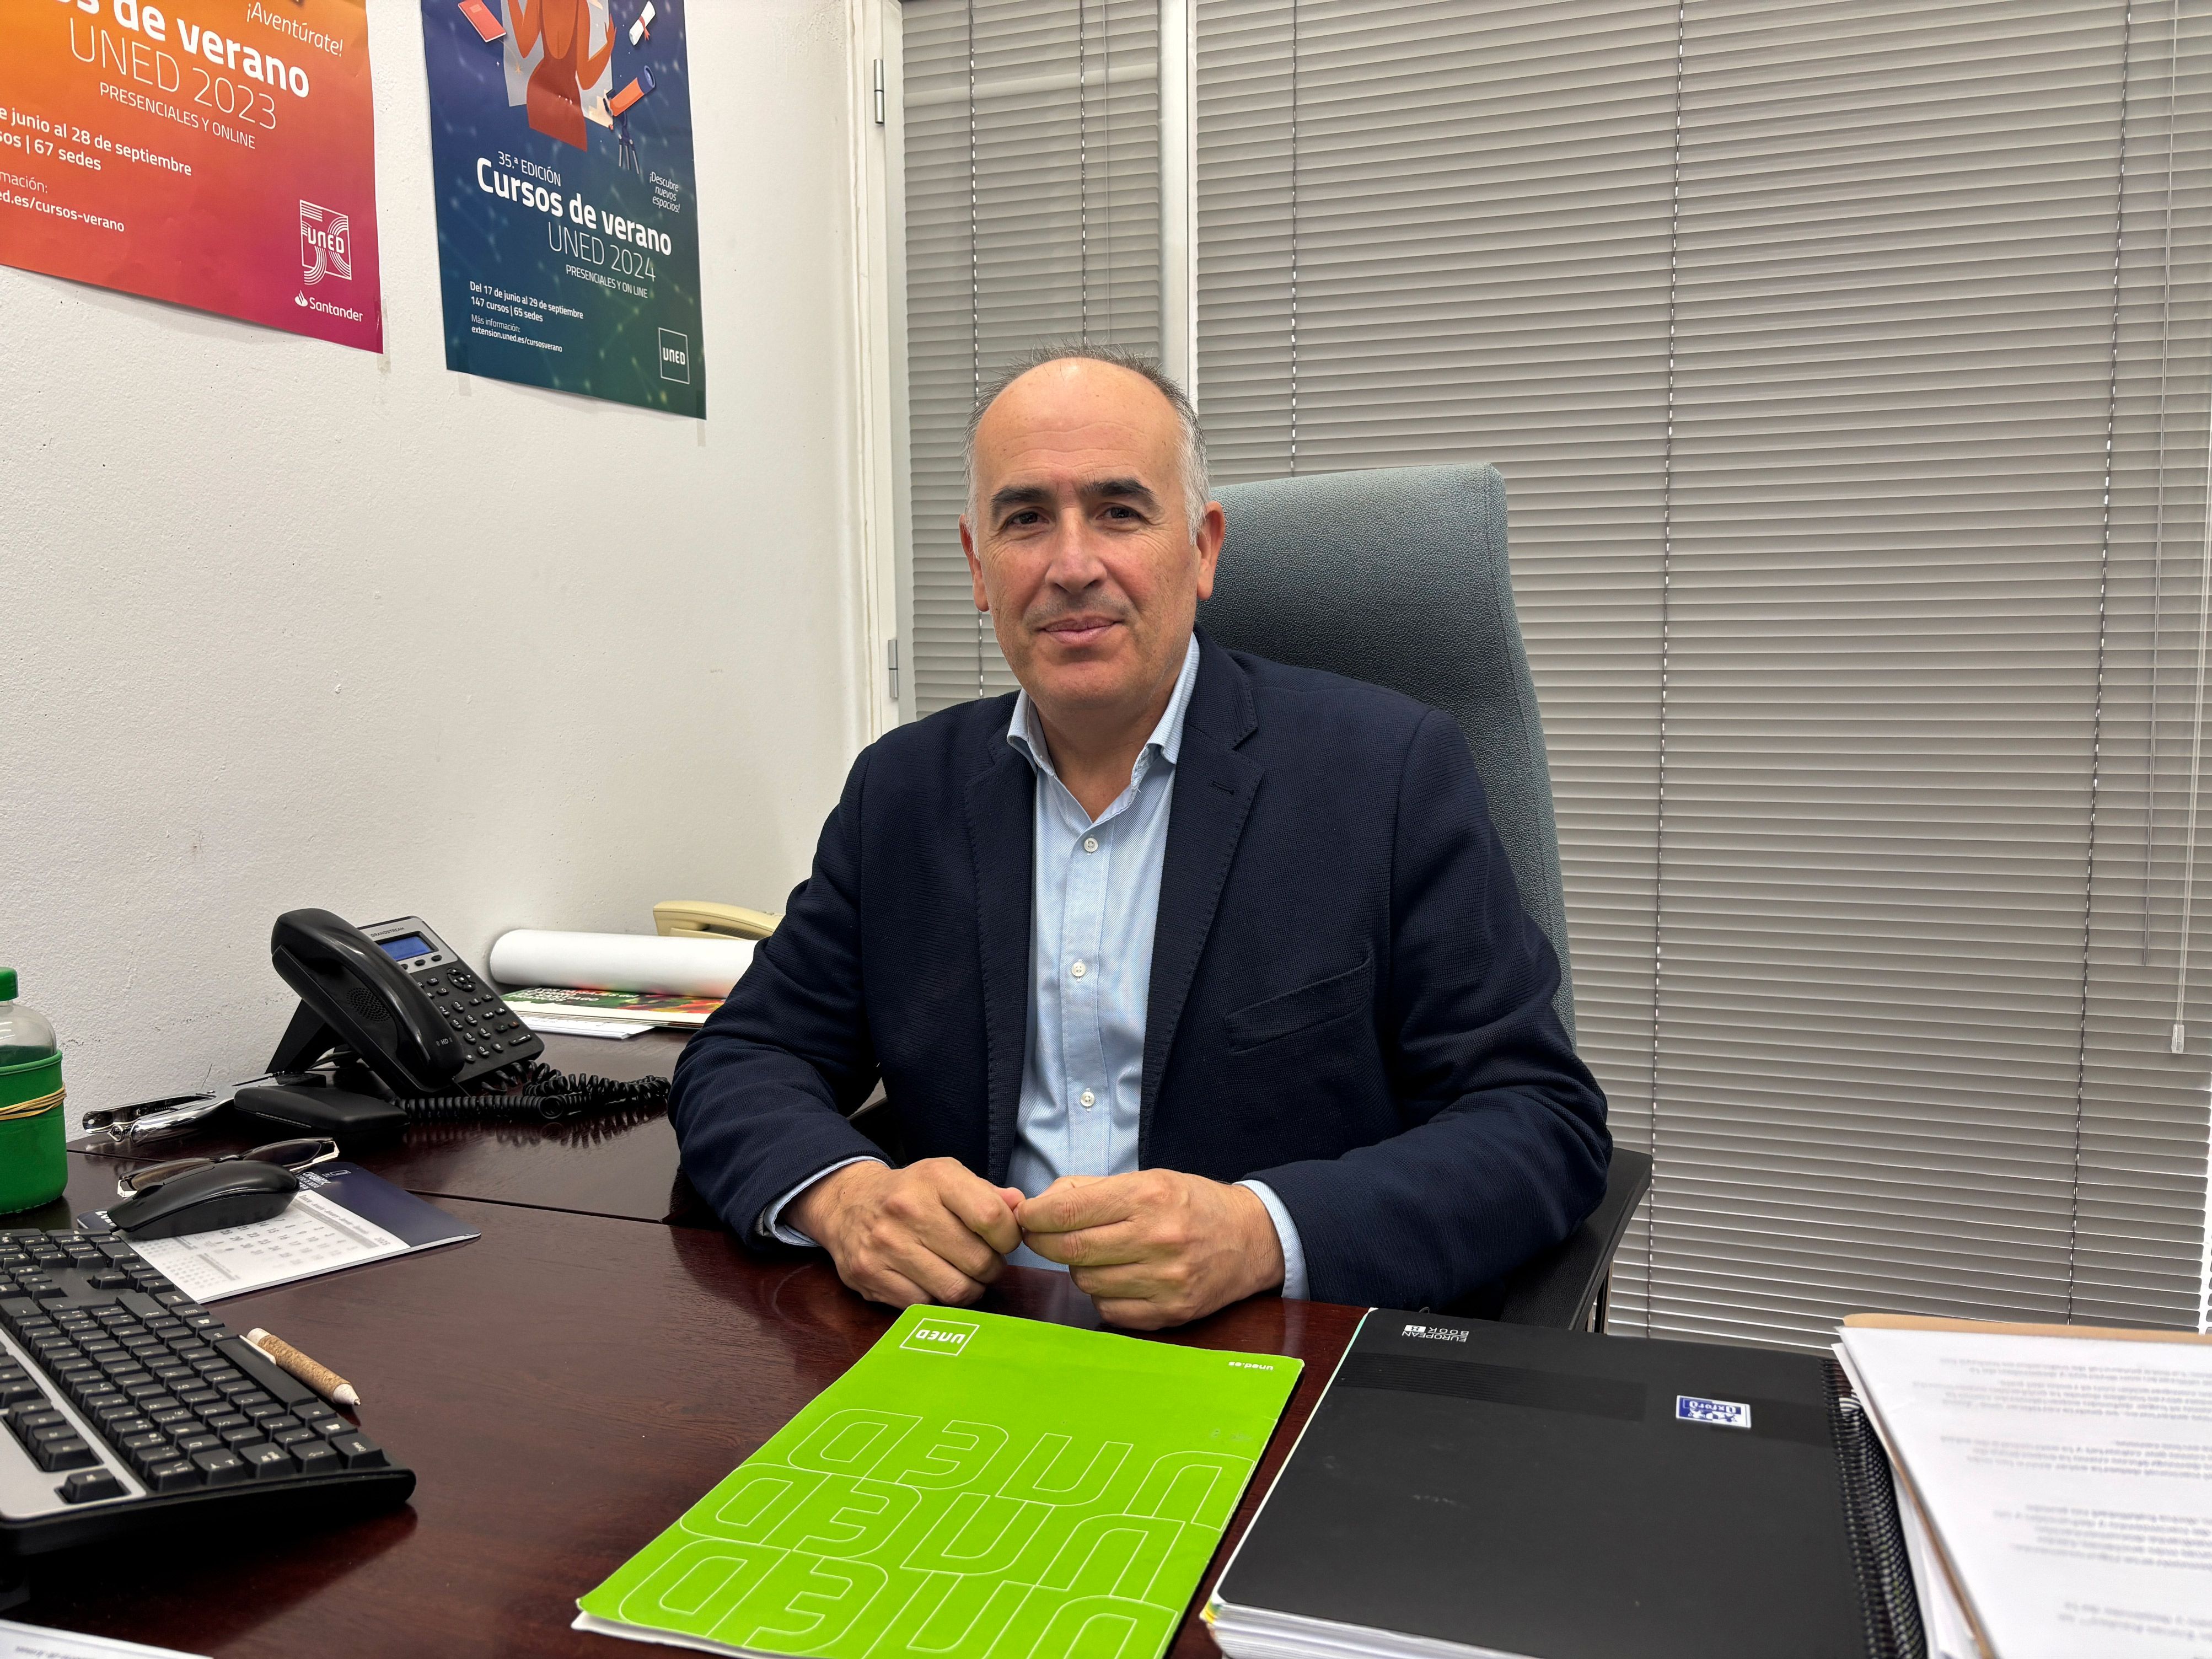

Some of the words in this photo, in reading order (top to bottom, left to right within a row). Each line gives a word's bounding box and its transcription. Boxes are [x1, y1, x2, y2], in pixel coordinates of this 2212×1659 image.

[246, 2, 343, 57] ¡Aventúrate!
[113, 0, 165, 41] de
[176, 18, 309, 98] verano
[70, 17, 180, 92] UNED
[192, 67, 276, 130] 2023
[100, 81, 199, 128] PRESENCIALES
[201, 117, 209, 132] Y
[212, 122, 255, 149] ONLINE
[11, 108, 50, 132] junio
[54, 123, 67, 138] al
[72, 127, 90, 145] 28
[94, 135, 111, 152] de
[115, 142, 192, 176] septiembre
[34, 139, 53, 156] 67
[58, 148, 101, 170] sedes
[521, 159, 561, 187] EDICIÓN
[649, 171, 679, 192] ¡Descubre
[477, 157, 563, 217] Cursos
[569, 193, 597, 229] de
[602, 210, 672, 256] verano
[652, 196, 680, 213] espacios!
[655, 186, 677, 201] nuevos
[0, 190, 125, 232] d.es/cursos-verano
[308, 227, 345, 254] UNED
[548, 222, 605, 265] UNED
[610, 244, 656, 282] 2024
[566, 264, 616, 288] PRESENCIALES
[616, 278, 622, 289] Y
[309, 297, 363, 322] Santander
[470, 281, 482, 293] Del
[484, 285, 492, 296] 17
[494, 288, 503, 298] de
[503, 290, 520, 302] junio
[522, 296, 528, 305] al
[529, 297, 538, 308] 29
[539, 300, 547, 310] de
[548, 304, 584, 319] septiembre
[471, 296, 485, 307] 147
[486, 301, 509, 314] cursos
[514, 307, 523, 317] 65
[524, 310, 543, 322] sedes
[471, 314, 484, 325] Más
[486, 317, 520, 332] información:
[471, 326, 563, 352] extension.uned.es/cursosverano
[663, 347, 685, 365] UNED
[371, 926, 405, 938] GRANDSTREAM
[915, 1329, 966, 1344] UNED
[1402, 1331, 1467, 1342] EUROPEAN
[1429, 1327, 1469, 1336] BOOK
[1228, 1361, 1274, 1371] uned.es
[1689, 1401, 1736, 1413] Oxford
[788, 1408, 1256, 1532] UNED
[680, 1463, 1186, 1603] UNED
